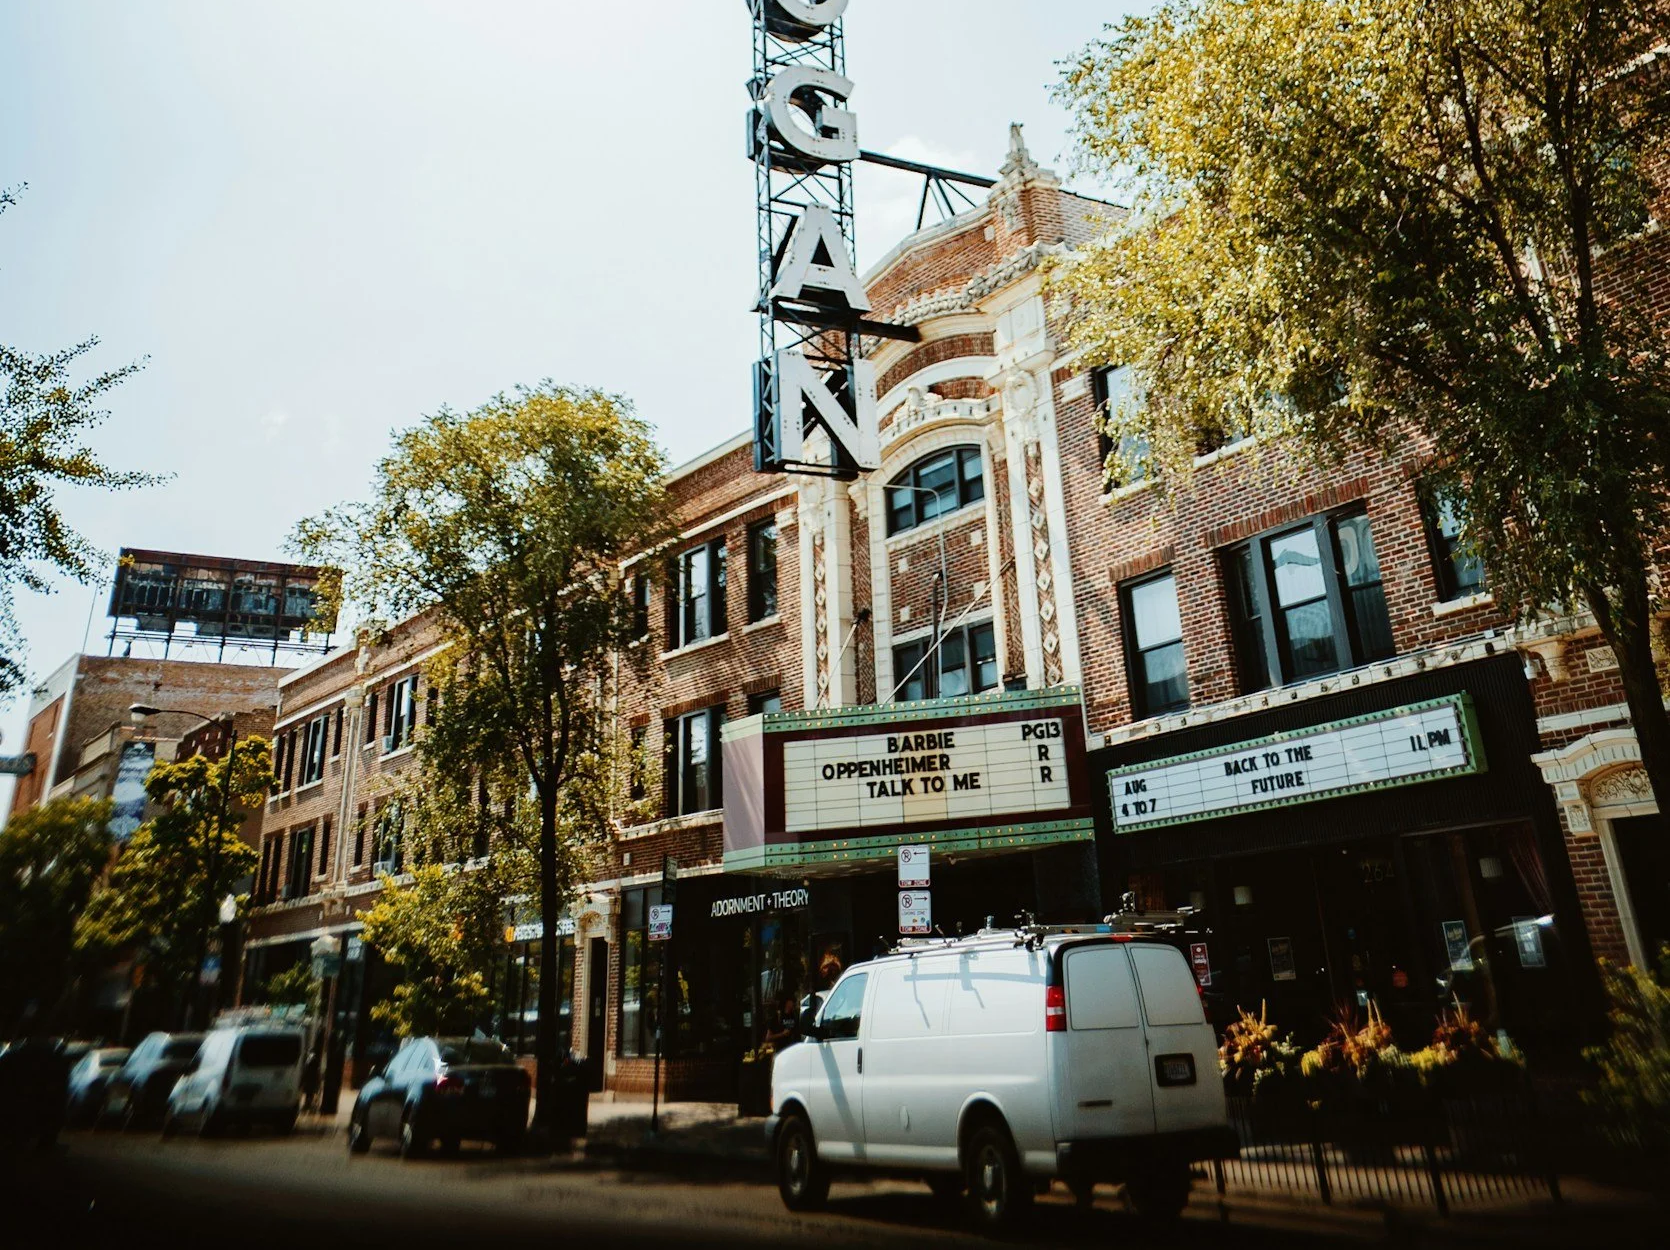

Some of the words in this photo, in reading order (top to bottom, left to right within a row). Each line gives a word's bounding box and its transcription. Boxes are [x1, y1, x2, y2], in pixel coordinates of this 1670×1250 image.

[887, 732, 955, 753] BARBIE
[1037, 744, 1050, 761] R
[822, 754, 951, 780] OPPENHEIMER
[1224, 756, 1258, 776] BACK
[1262, 752, 1280, 768] TO
[1284, 745, 1313, 763] THE
[866, 778, 915, 798] TALK
[920, 776, 944, 794] TO
[953, 772, 981, 791] ME
[1040, 766, 1053, 783] R
[1251, 771, 1305, 794] FUTURE
[1125, 778, 1147, 796] AUG
[1122, 803, 1129, 817] 4
[1132, 800, 1147, 815] TO
[1149, 798, 1156, 812] 7
[710, 893, 766, 917] ADORNMENT
[772, 888, 809, 909] THEORY
